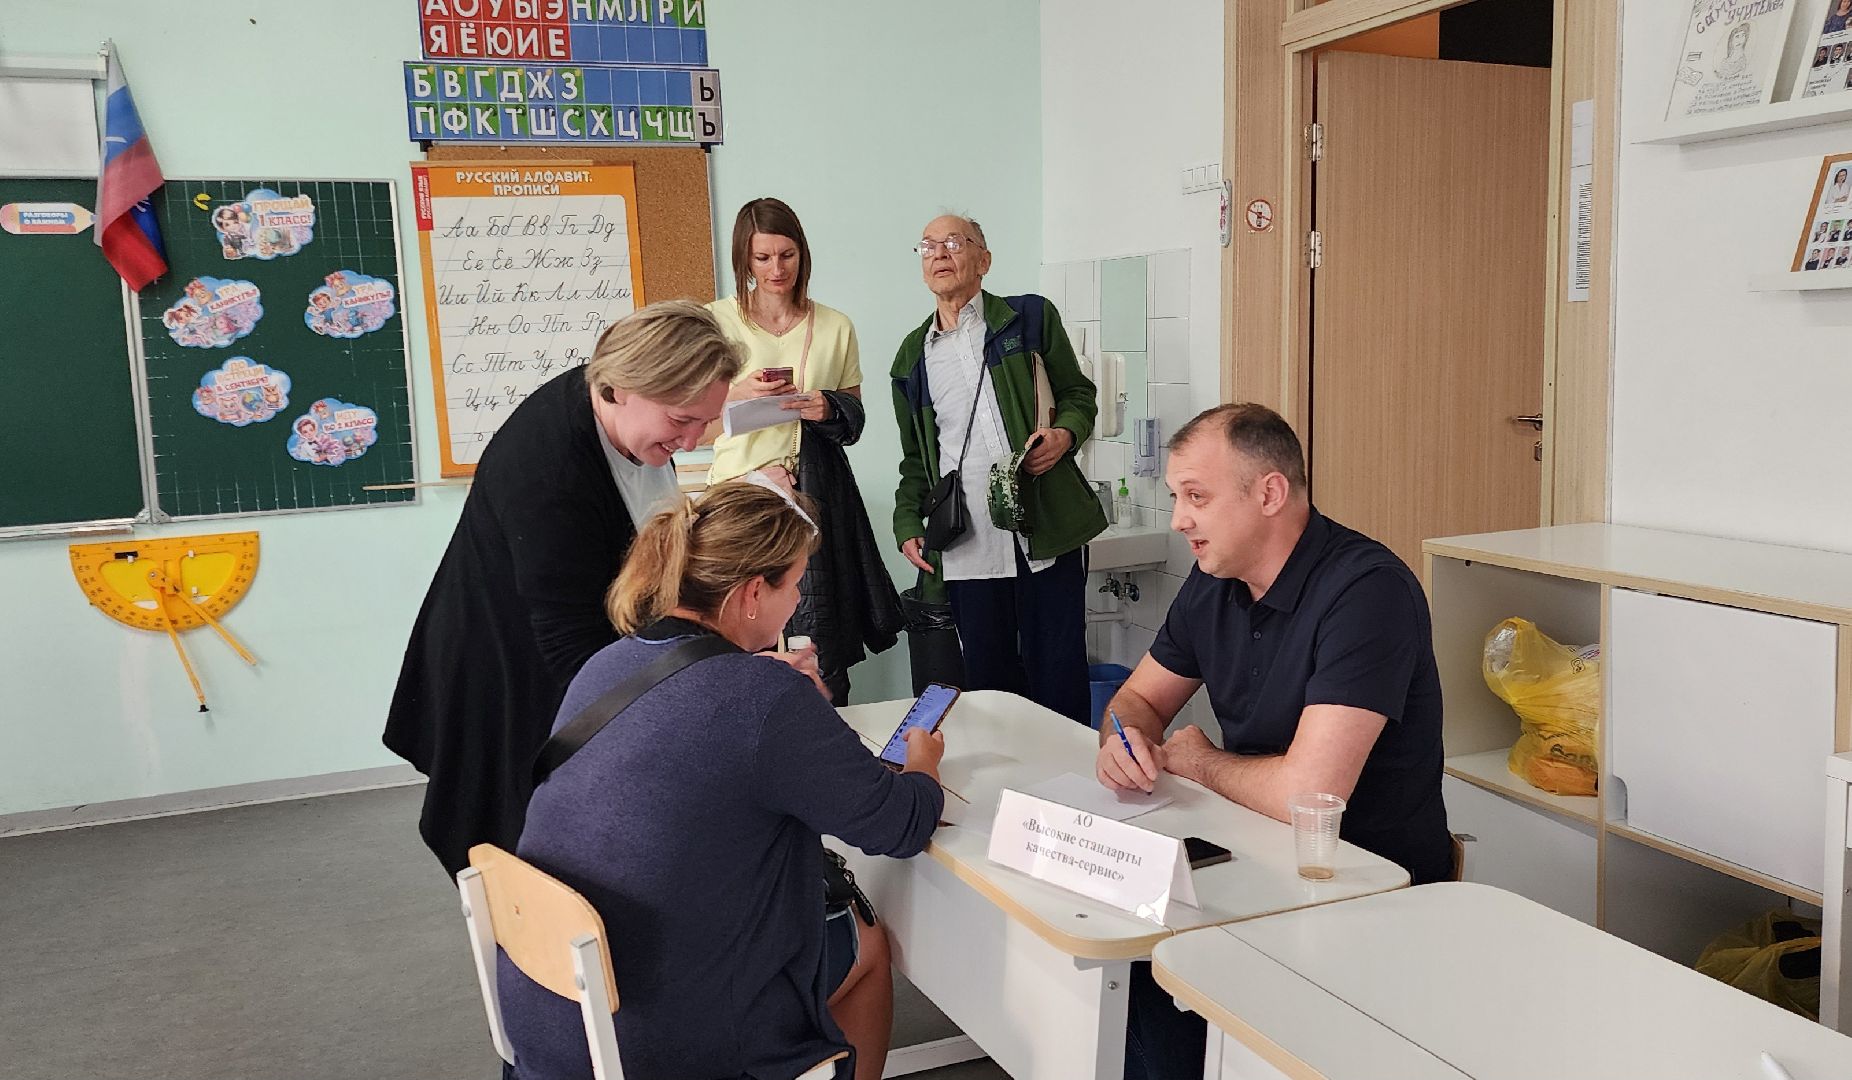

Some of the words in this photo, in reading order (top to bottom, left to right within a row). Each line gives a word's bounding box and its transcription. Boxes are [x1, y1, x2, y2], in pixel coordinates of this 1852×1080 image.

[429, 25, 448, 53] Я
[460, 23, 478, 54] Ё
[485, 27, 513, 55] Ю
[516, 27, 539, 56] И
[548, 29, 566, 56] Е
[413, 68, 432, 98] Б
[444, 70, 461, 98] В
[474, 71, 490, 98] Г
[500, 71, 524, 102] Д
[527, 71, 554, 99] Ж
[561, 72, 578, 100] З
[414, 106, 436, 134] П
[442, 107, 468, 135] Ф
[475, 107, 496, 135] К
[504, 108, 523, 135] Т
[530, 108, 557, 136] Ш
[562, 108, 581, 136] С
[590, 109, 610, 136] Х
[617, 110, 639, 140] Ц
[645, 110, 663, 137] Ч
[669, 111, 695, 141] Щ
[455, 168, 520, 184] РУССКИЙ
[523, 170, 593, 184] АЛФАВИТ.
[493, 184, 560, 196] ПРОПИСИ
[268, 215, 311, 226] КЛАСС!
[1073, 813, 1093, 828] АО
[1021, 818, 1077, 845] «Высокие
[1078, 837, 1142, 867] стандарты
[1025, 841, 1125, 882] качества-сервис»
